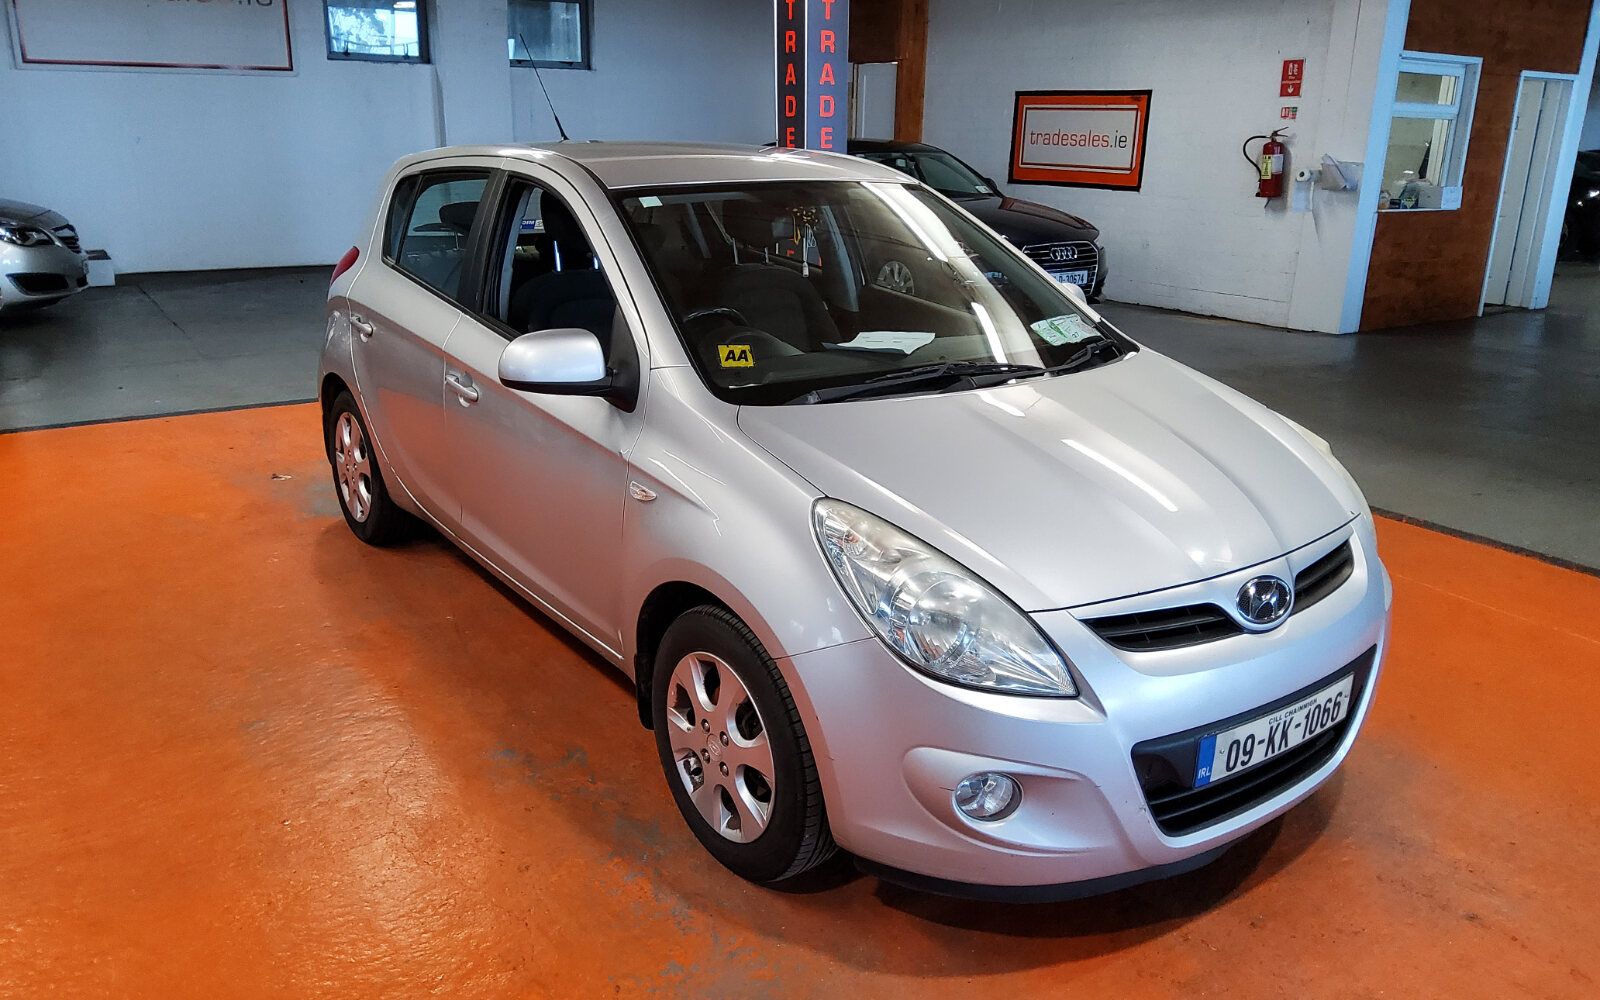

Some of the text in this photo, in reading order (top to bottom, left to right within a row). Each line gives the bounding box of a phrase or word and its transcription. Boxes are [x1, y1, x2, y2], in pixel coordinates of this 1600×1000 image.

[785, 0, 796, 148] TRADE
[820, 0, 835, 148] TRADE
[1030, 129, 1128, 149] tradesales.ie
[724, 349, 749, 362] AA
[1268, 713, 1283, 725] CILL
[1225, 691, 1342, 773] 09-KK-1066
[1197, 768, 1211, 779] IRL
